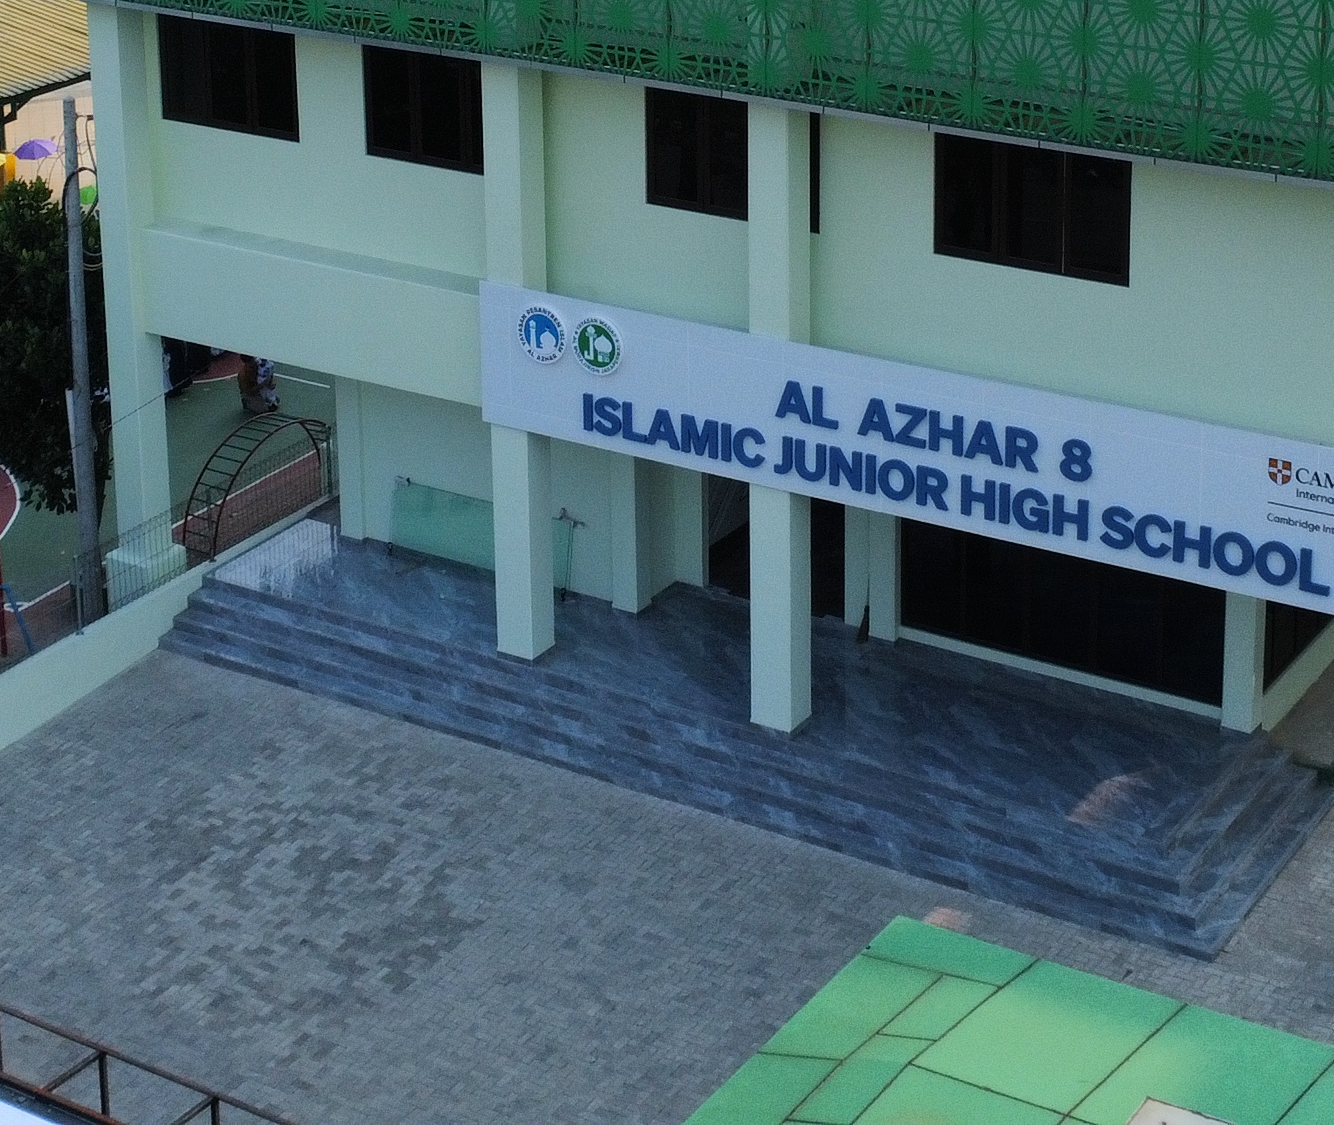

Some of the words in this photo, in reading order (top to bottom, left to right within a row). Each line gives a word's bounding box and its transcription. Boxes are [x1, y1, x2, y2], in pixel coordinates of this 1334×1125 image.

[517, 313, 527, 346] YAYASAN
[526, 306, 561, 328] PESANTREN
[536, 353, 557, 362] AZHAR
[775, 380, 839, 430] AL
[857, 397, 1039, 473] AZHAR
[1059, 439, 1093, 482] 8
[582, 392, 765, 468] ISLAMIC
[774, 435, 948, 511] JUNIOR
[960, 474, 1090, 542] HIGH
[1099, 505, 1330, 597] SCHOOL
[1266, 512, 1321, 533] Cambridge
